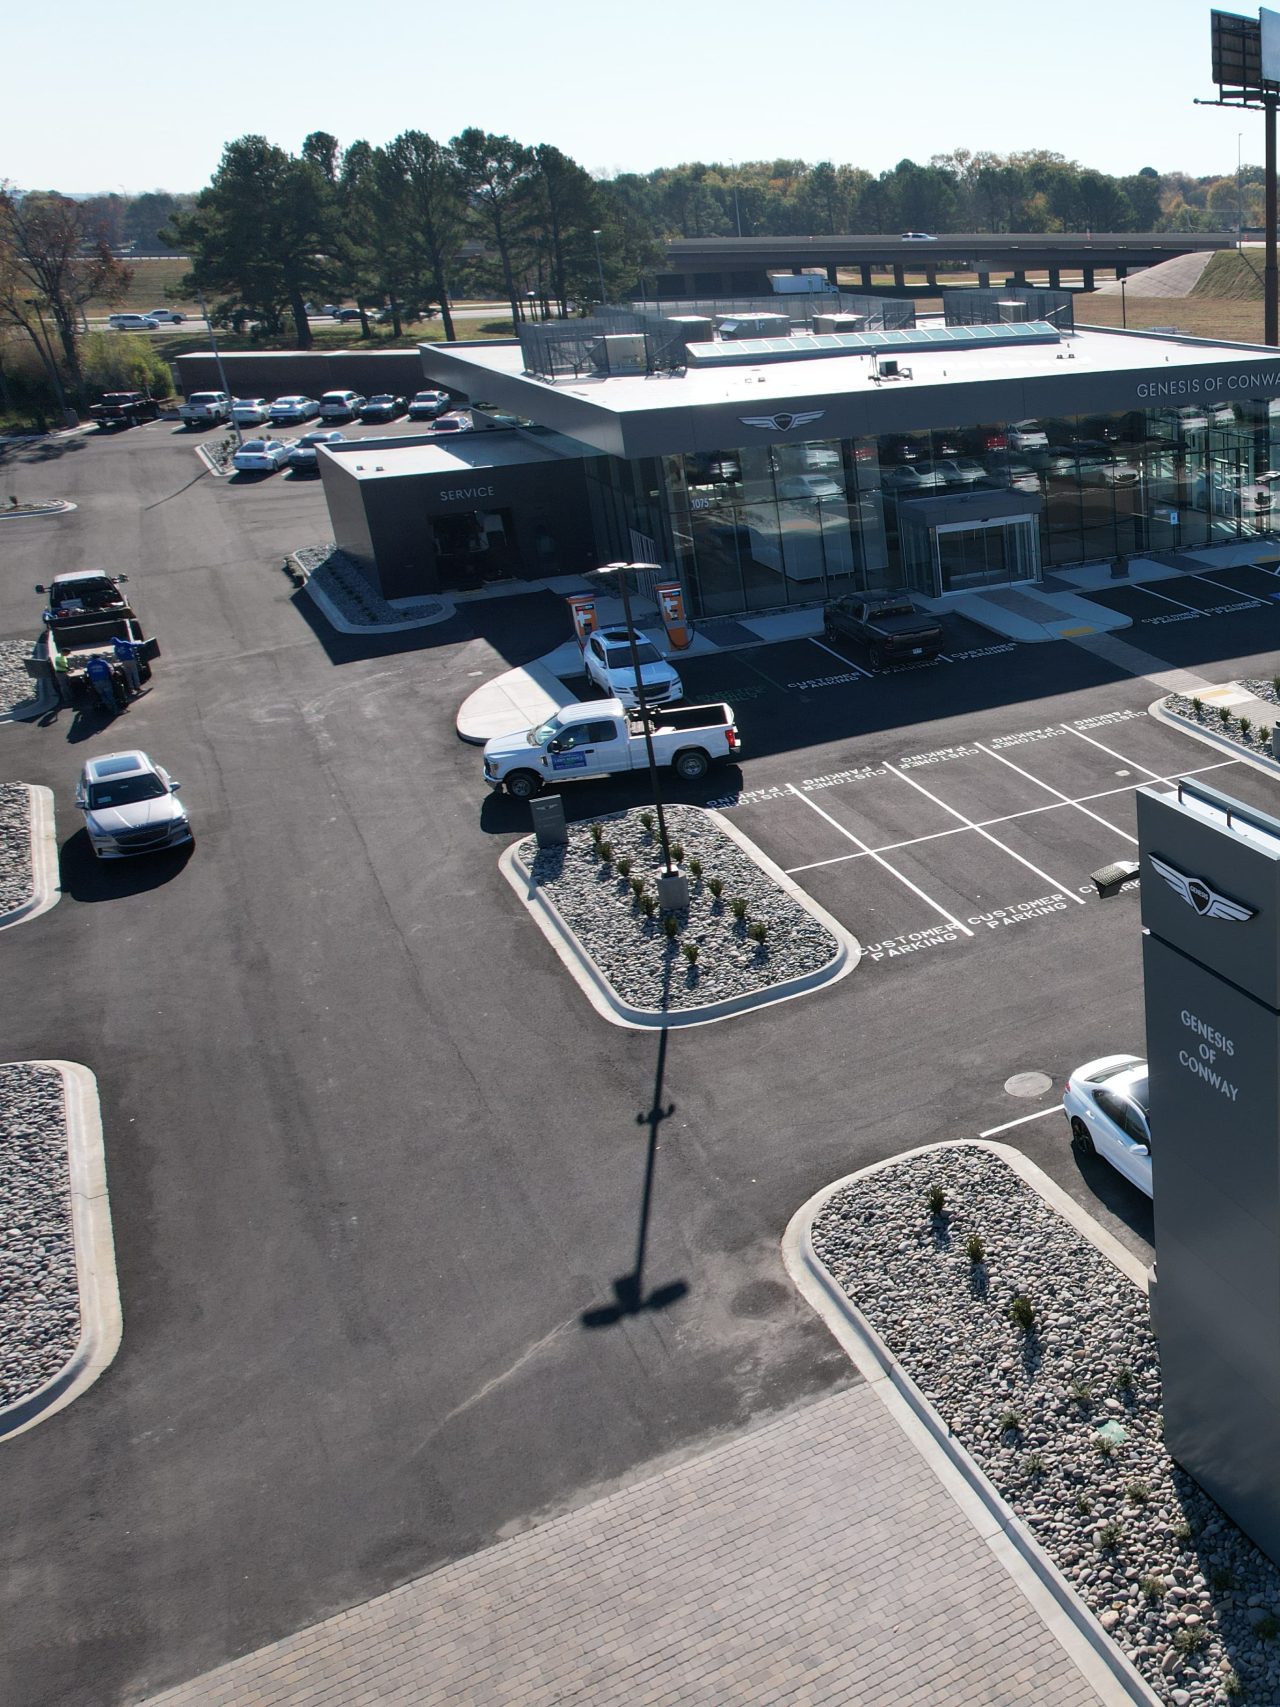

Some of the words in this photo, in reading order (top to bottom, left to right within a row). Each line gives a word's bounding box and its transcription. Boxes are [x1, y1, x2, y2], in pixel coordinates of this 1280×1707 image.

[1136, 378, 1200, 397] GENESIS
[1204, 377, 1223, 391] OF
[440, 486, 496, 501] SERVICE
[691, 498, 709, 509] 1075
[787, 671, 862, 688] CUSTOMER
[1073, 709, 1133, 727] PARKING
[1077, 710, 1148, 731] CUSTOMER
[989, 729, 1067, 750] CUSTOMER
[992, 726, 1054, 744] PARKING
[899, 749, 980, 770] CUSTOMER
[900, 745, 967, 764] PARKING
[801, 768, 887, 792] CUSTOMER
[803, 765, 872, 786] PARKING
[967, 893, 1066, 925] CUSTOMER
[986, 902, 1068, 929] PARKING
[855, 922, 960, 956] CUSTOMER
[871, 933, 957, 961] PARKING
[1181, 1010, 1234, 1056] GENESIS
[1199, 1044, 1216, 1064] OF
[1179, 1050, 1238, 1101] CONWAY
